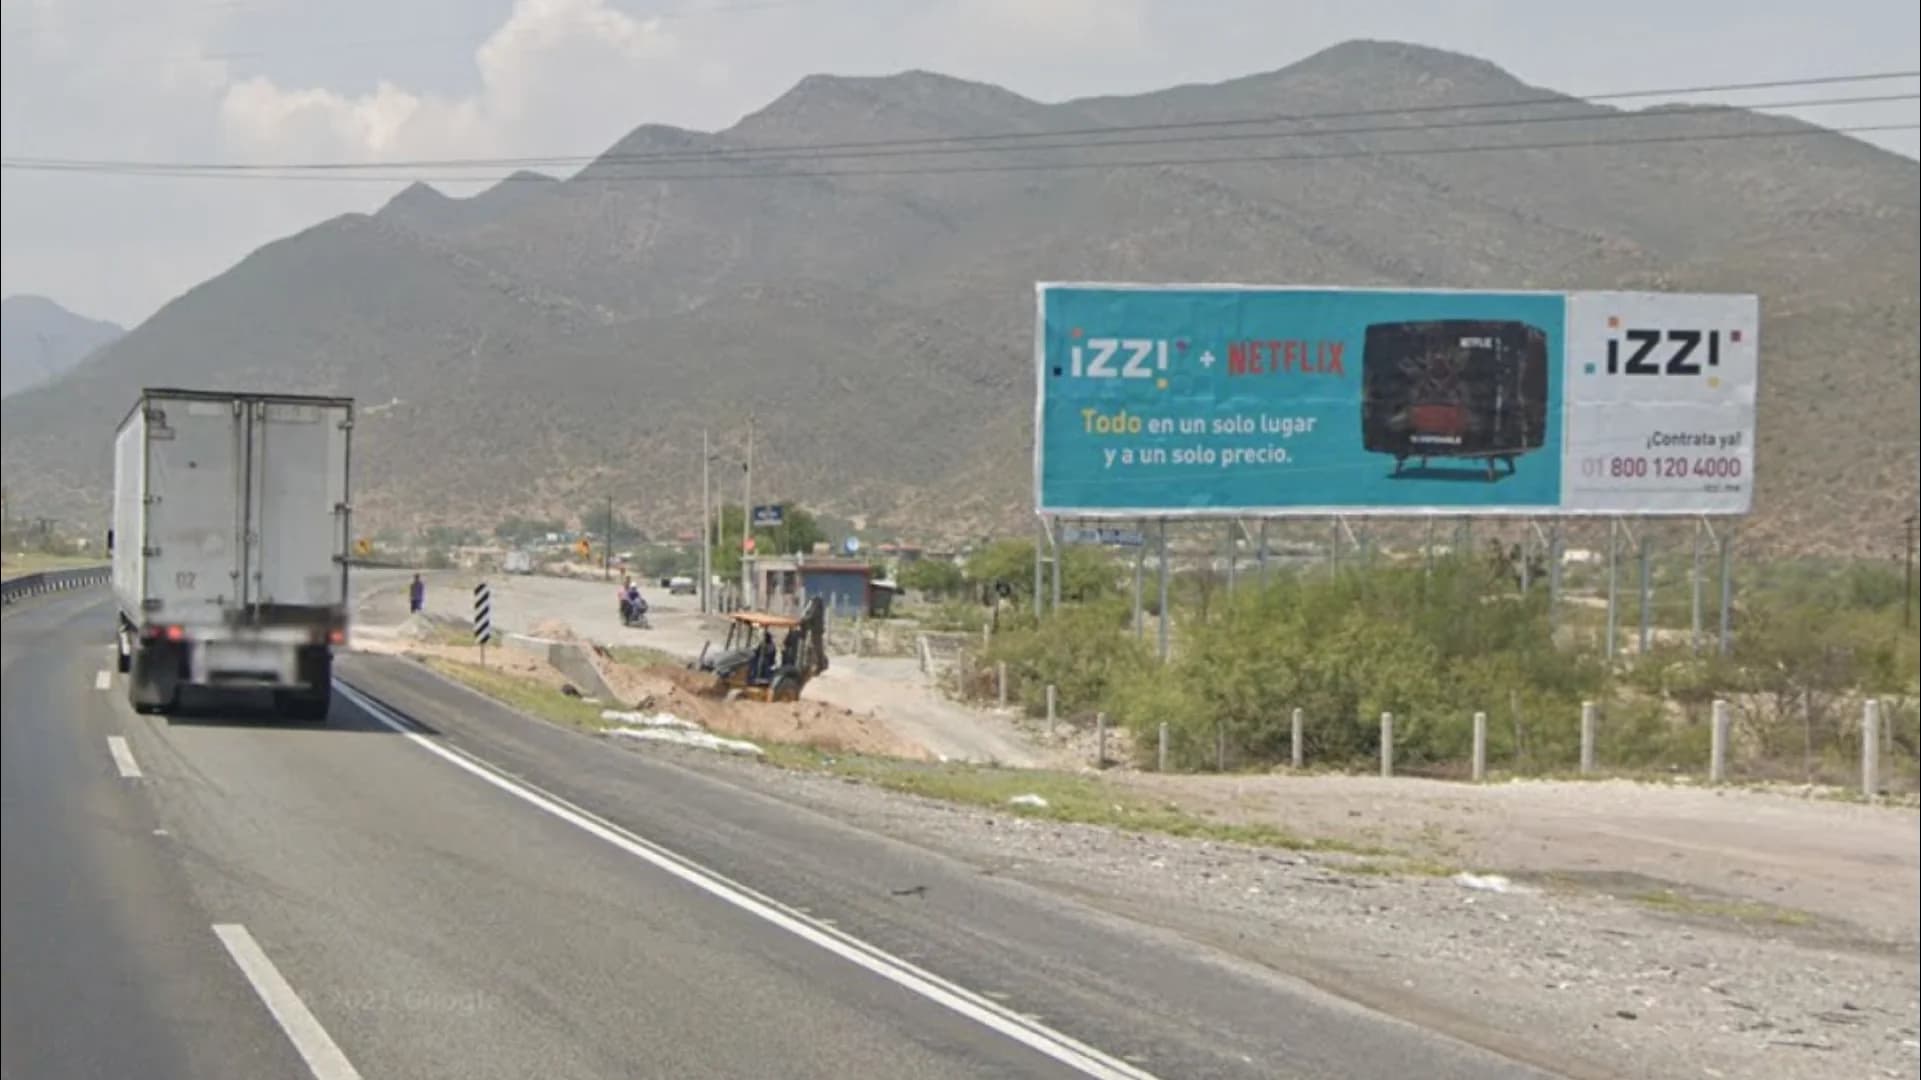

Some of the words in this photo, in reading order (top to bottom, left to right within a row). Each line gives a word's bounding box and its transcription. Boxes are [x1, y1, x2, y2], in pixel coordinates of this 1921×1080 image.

[1227, 340, 1345, 376] NETFLIX
[1081, 409, 1142, 434] Todo
[1148, 417, 1174, 434] en
[1180, 417, 1206, 434] un
[1213, 413, 1255, 434] solo
[1260, 413, 1317, 441] lugar
[1647, 431, 1716, 449] ¡Contrata
[1719, 431, 1742, 450] ya!
[1104, 448, 1116, 467] y
[1122, 448, 1134, 464] a
[1140, 447, 1166, 464] un
[1172, 443, 1215, 464] solo
[1222, 444, 1292, 467] precio.
[1611, 456, 1647, 478] 800
[1653, 456, 1688, 478] 120
[1693, 457, 1741, 478] 4000
